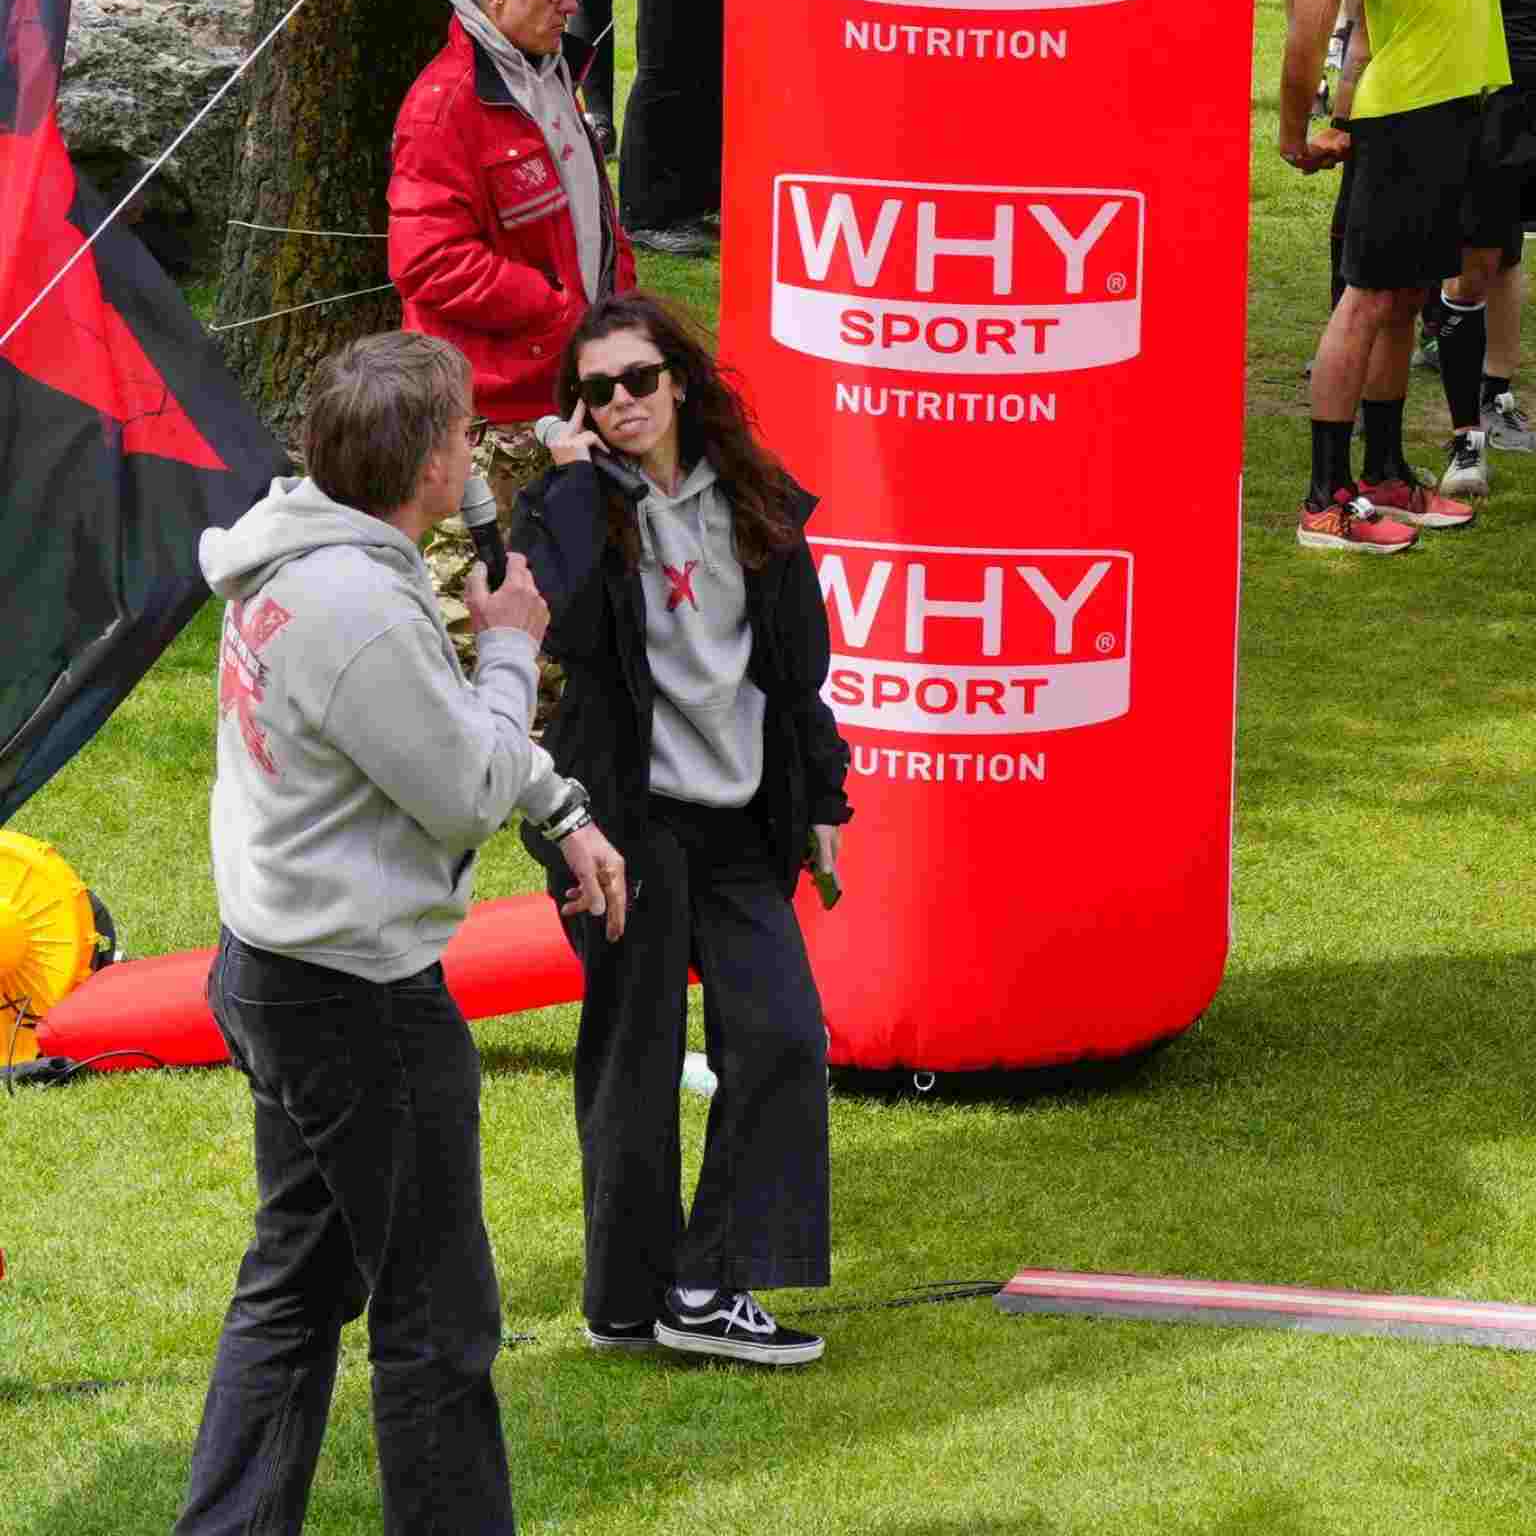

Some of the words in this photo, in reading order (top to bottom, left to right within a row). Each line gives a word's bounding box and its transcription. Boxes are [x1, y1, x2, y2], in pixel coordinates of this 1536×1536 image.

[844, 22, 1066, 58] NUTRITION
[840, 310, 1059, 354] SPORT
[835, 383, 1056, 422] NUTRITION
[830, 671, 1049, 715] SPORT
[852, 747, 1045, 781] UTRITION
